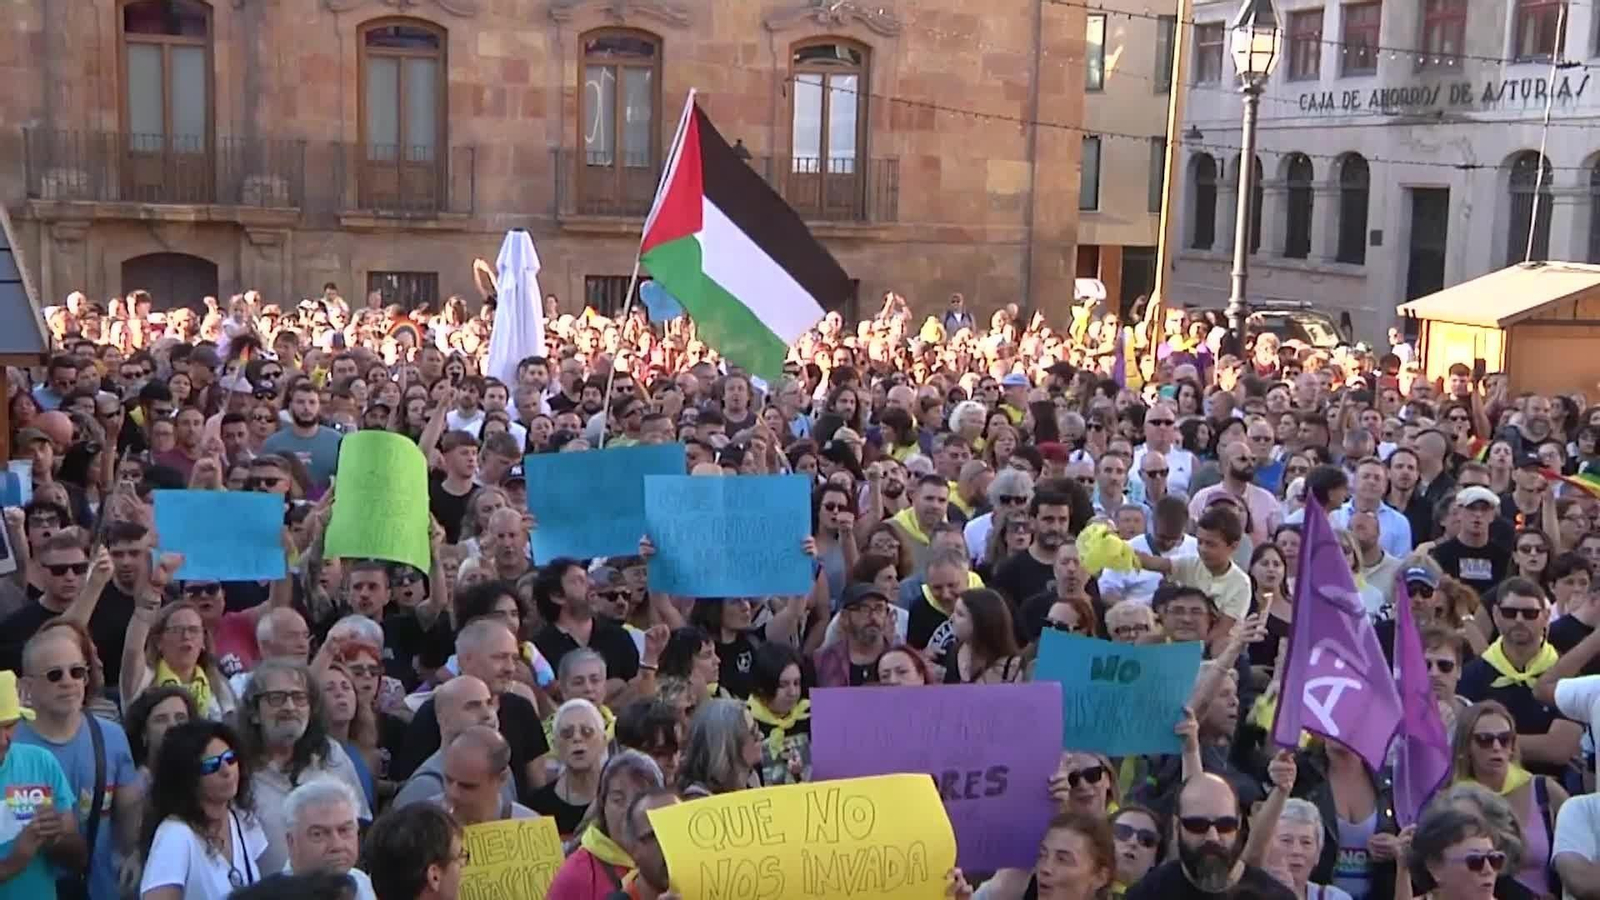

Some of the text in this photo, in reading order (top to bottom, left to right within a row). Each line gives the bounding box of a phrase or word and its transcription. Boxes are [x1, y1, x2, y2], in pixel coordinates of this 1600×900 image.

[1299, 75, 1590, 111] CAJA DE AHORROS DE ASTURIAS
[1091, 654, 1141, 684] NO
[13, 788, 44, 805] NO
[932, 765, 1009, 801] RES
[688, 787, 875, 851] QUE NO
[1339, 850, 1367, 865] NO
[699, 855, 785, 900] NOS
